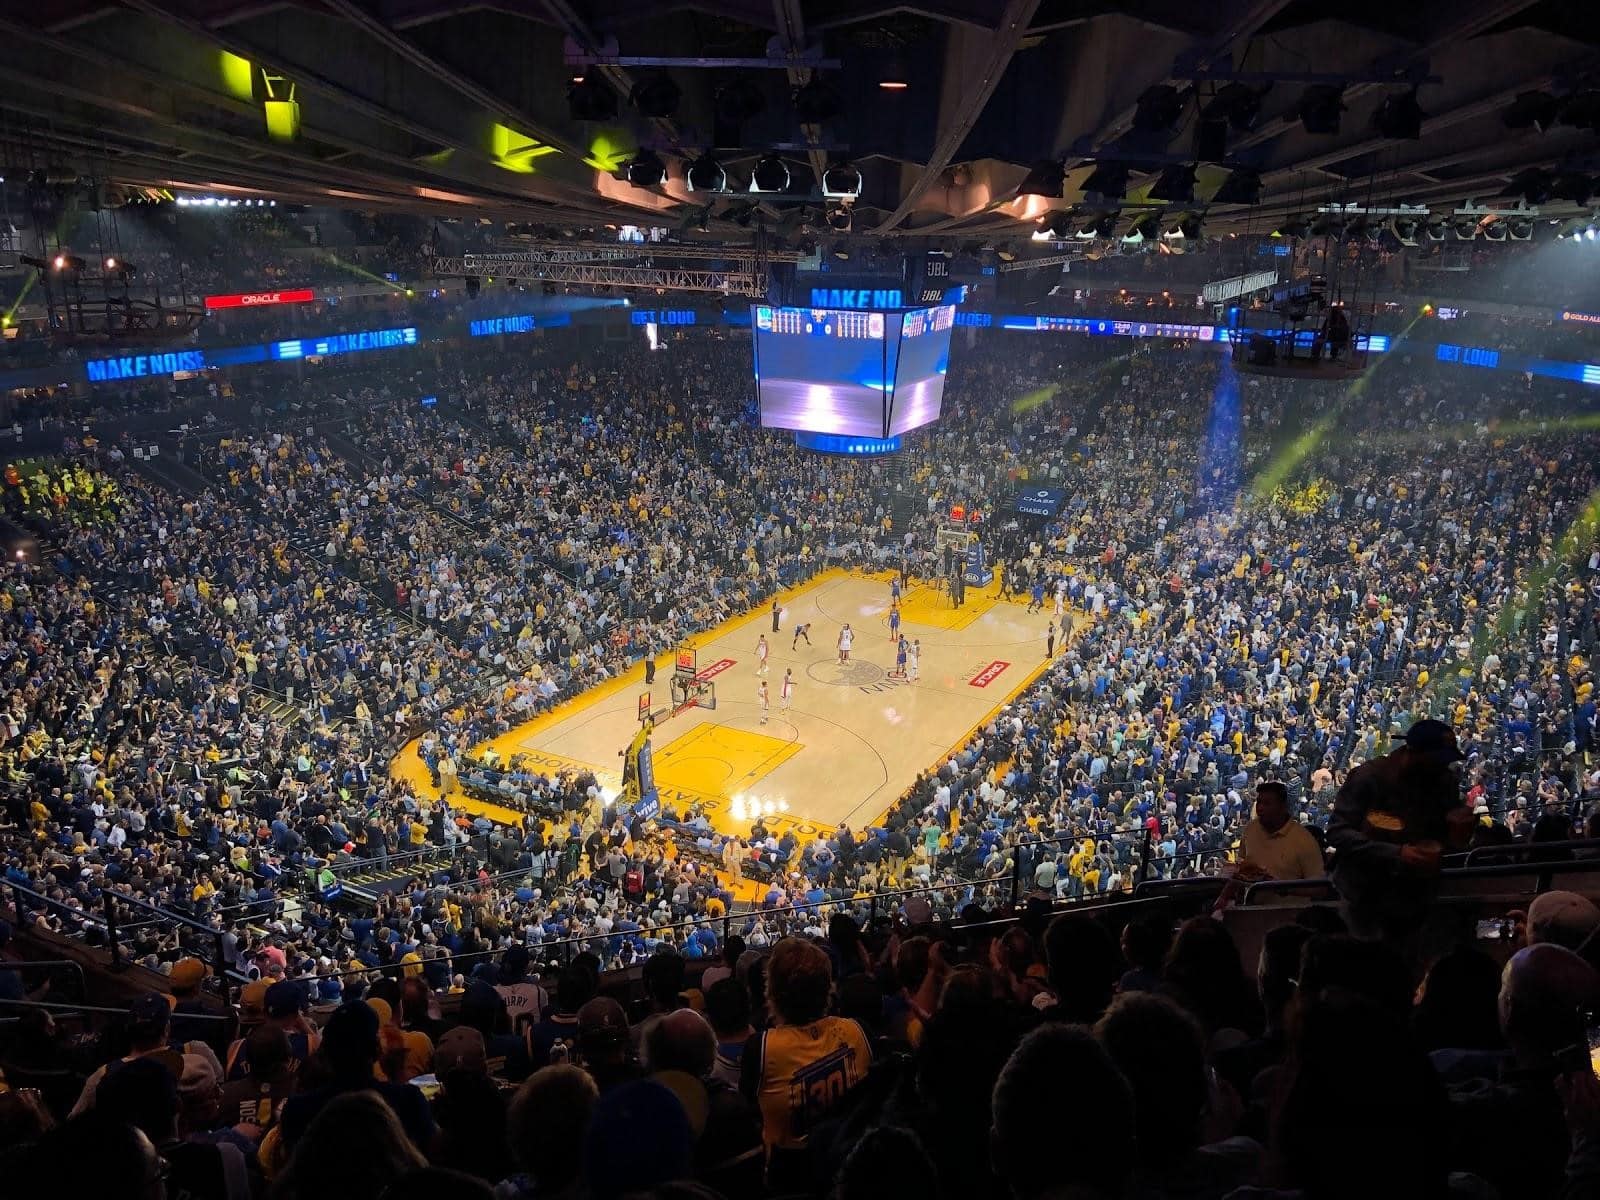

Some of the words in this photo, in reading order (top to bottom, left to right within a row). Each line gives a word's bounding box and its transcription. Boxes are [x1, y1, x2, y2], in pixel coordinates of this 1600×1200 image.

[927, 262, 949, 277] JBL
[241, 293, 281, 305] ORACLE
[811, 288, 871, 308] MAKE
[873, 289, 902, 308] NO
[921, 289, 942, 302] JBL
[660, 310, 695, 325] LOUD
[470, 318, 503, 337] MAKE
[87, 355, 148, 381] MAKE
[503, 994, 530, 1009] URRY
